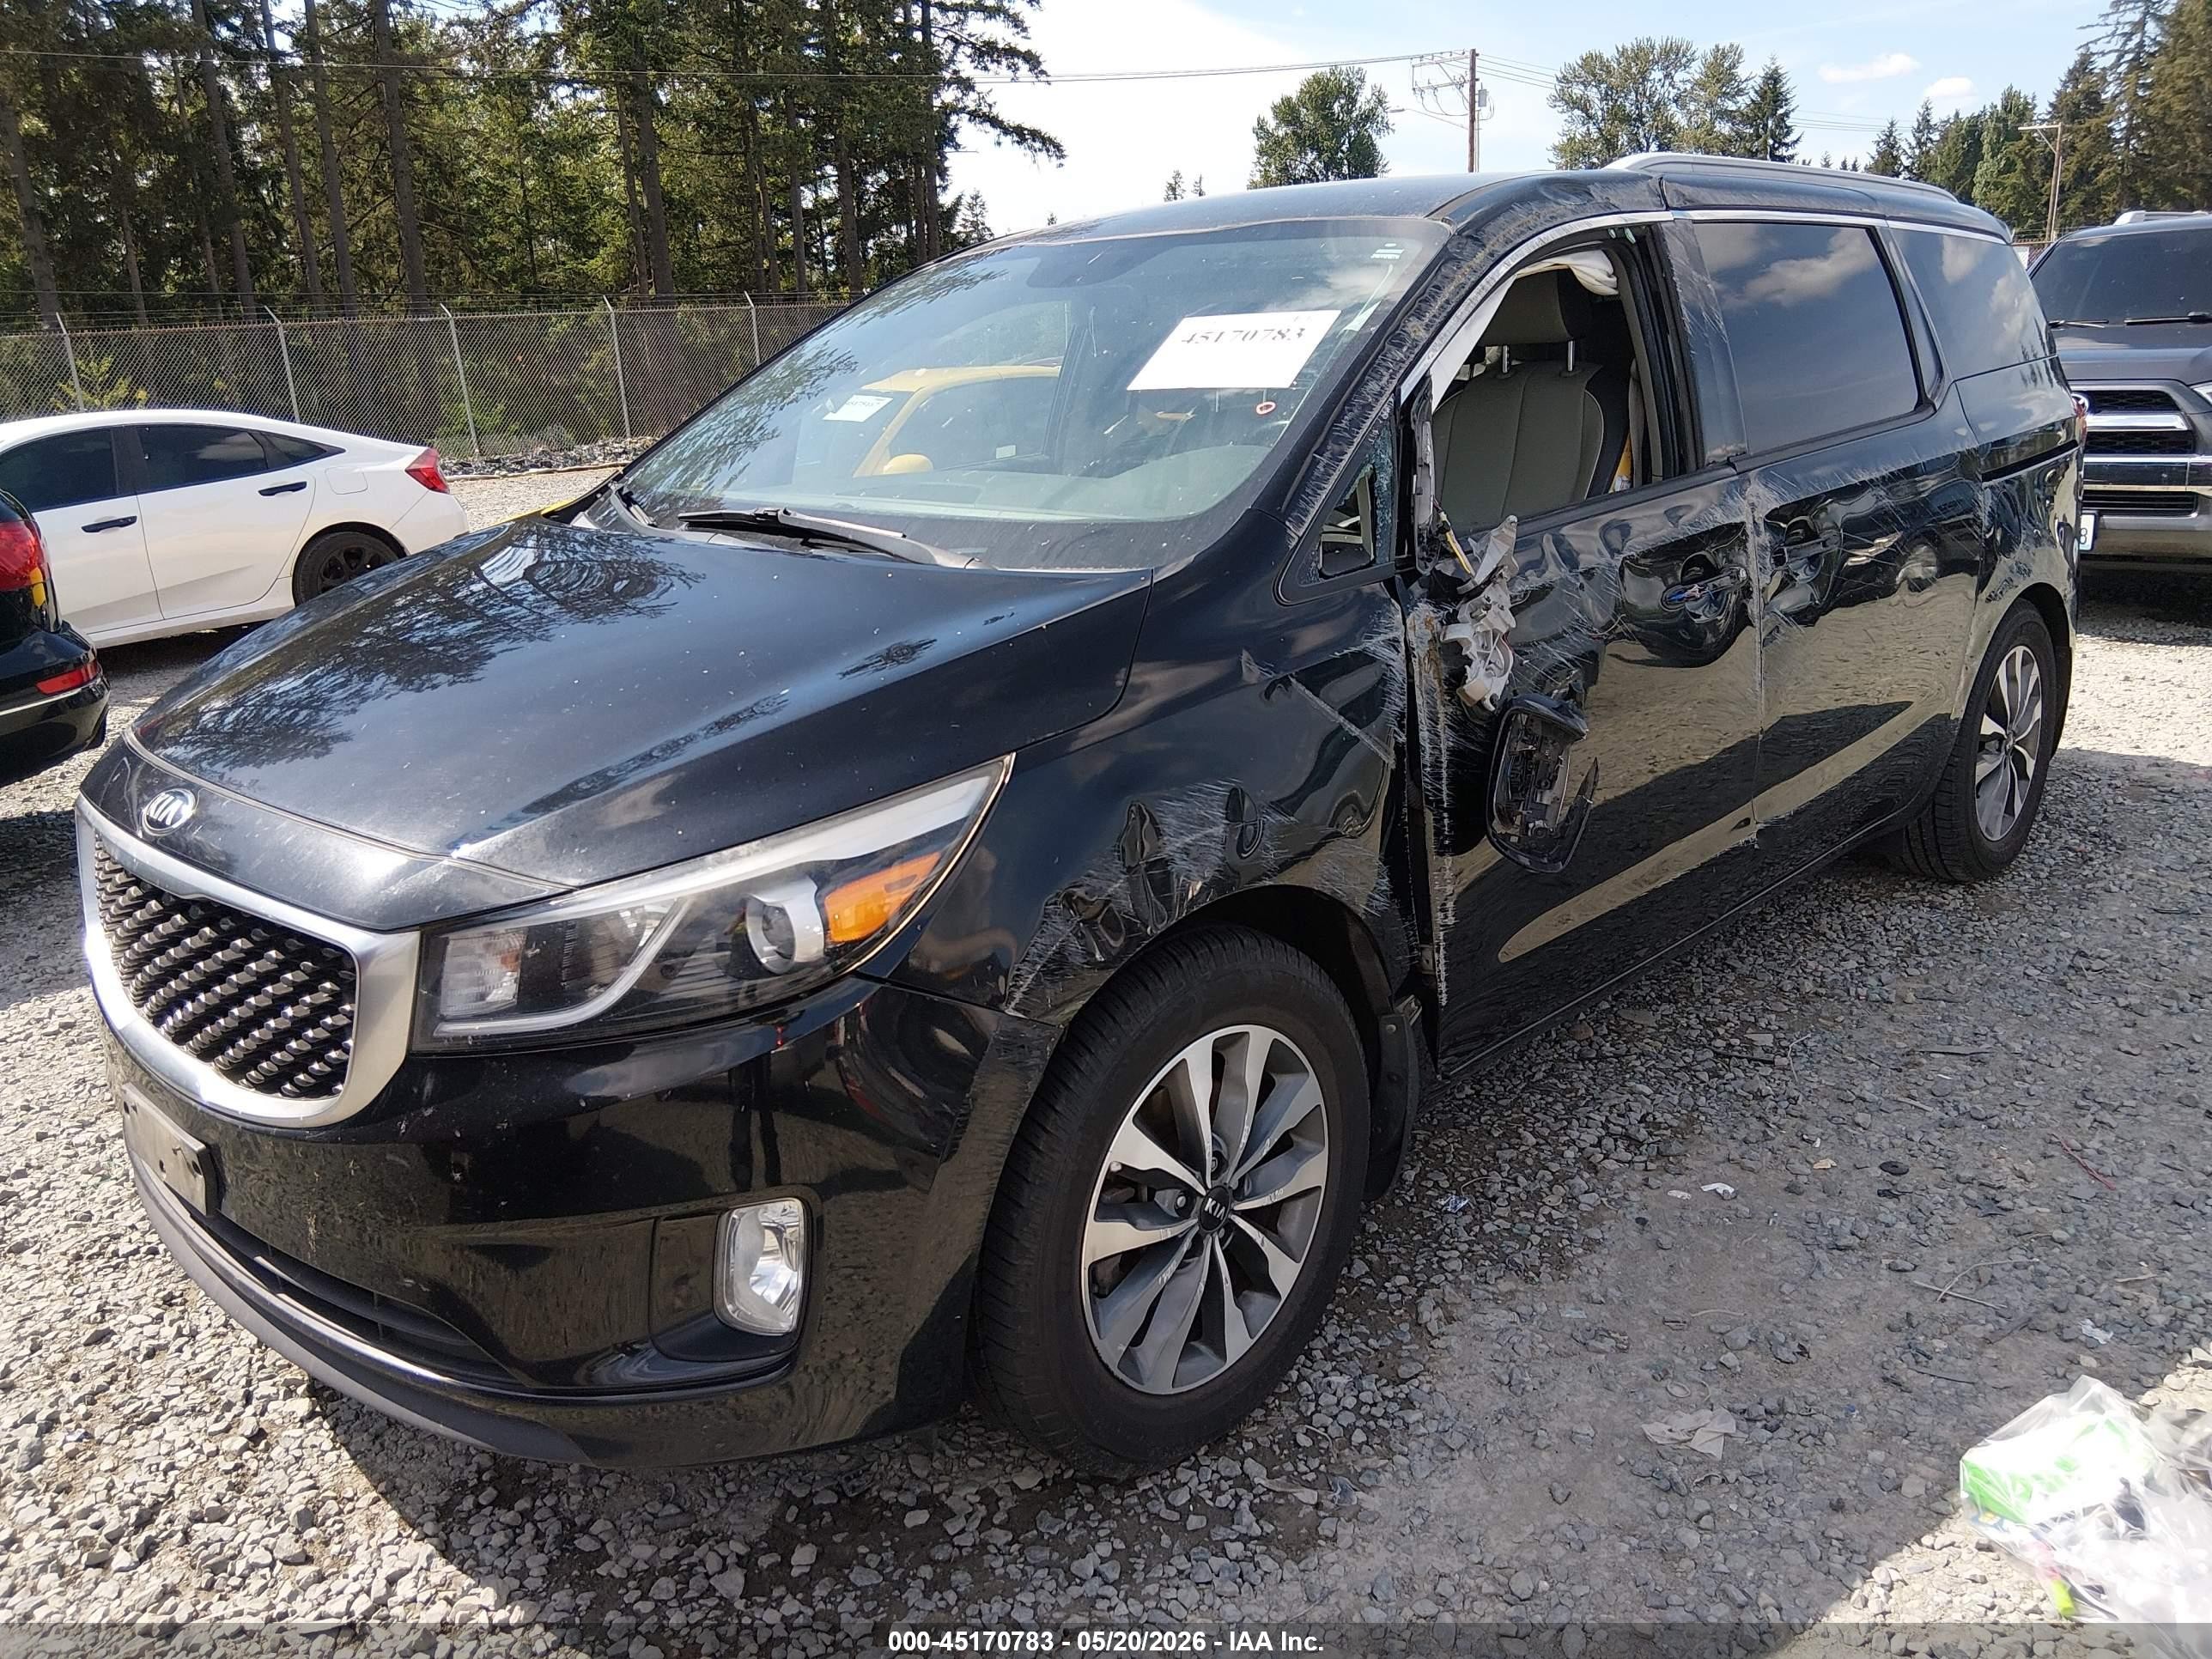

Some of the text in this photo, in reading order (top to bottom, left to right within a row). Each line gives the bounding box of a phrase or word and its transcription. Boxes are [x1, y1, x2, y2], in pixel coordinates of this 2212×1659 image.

[1181, 328, 1306, 344] 45170783
[149, 793, 185, 826] KIA
[1204, 1198, 1226, 1220] KIA
